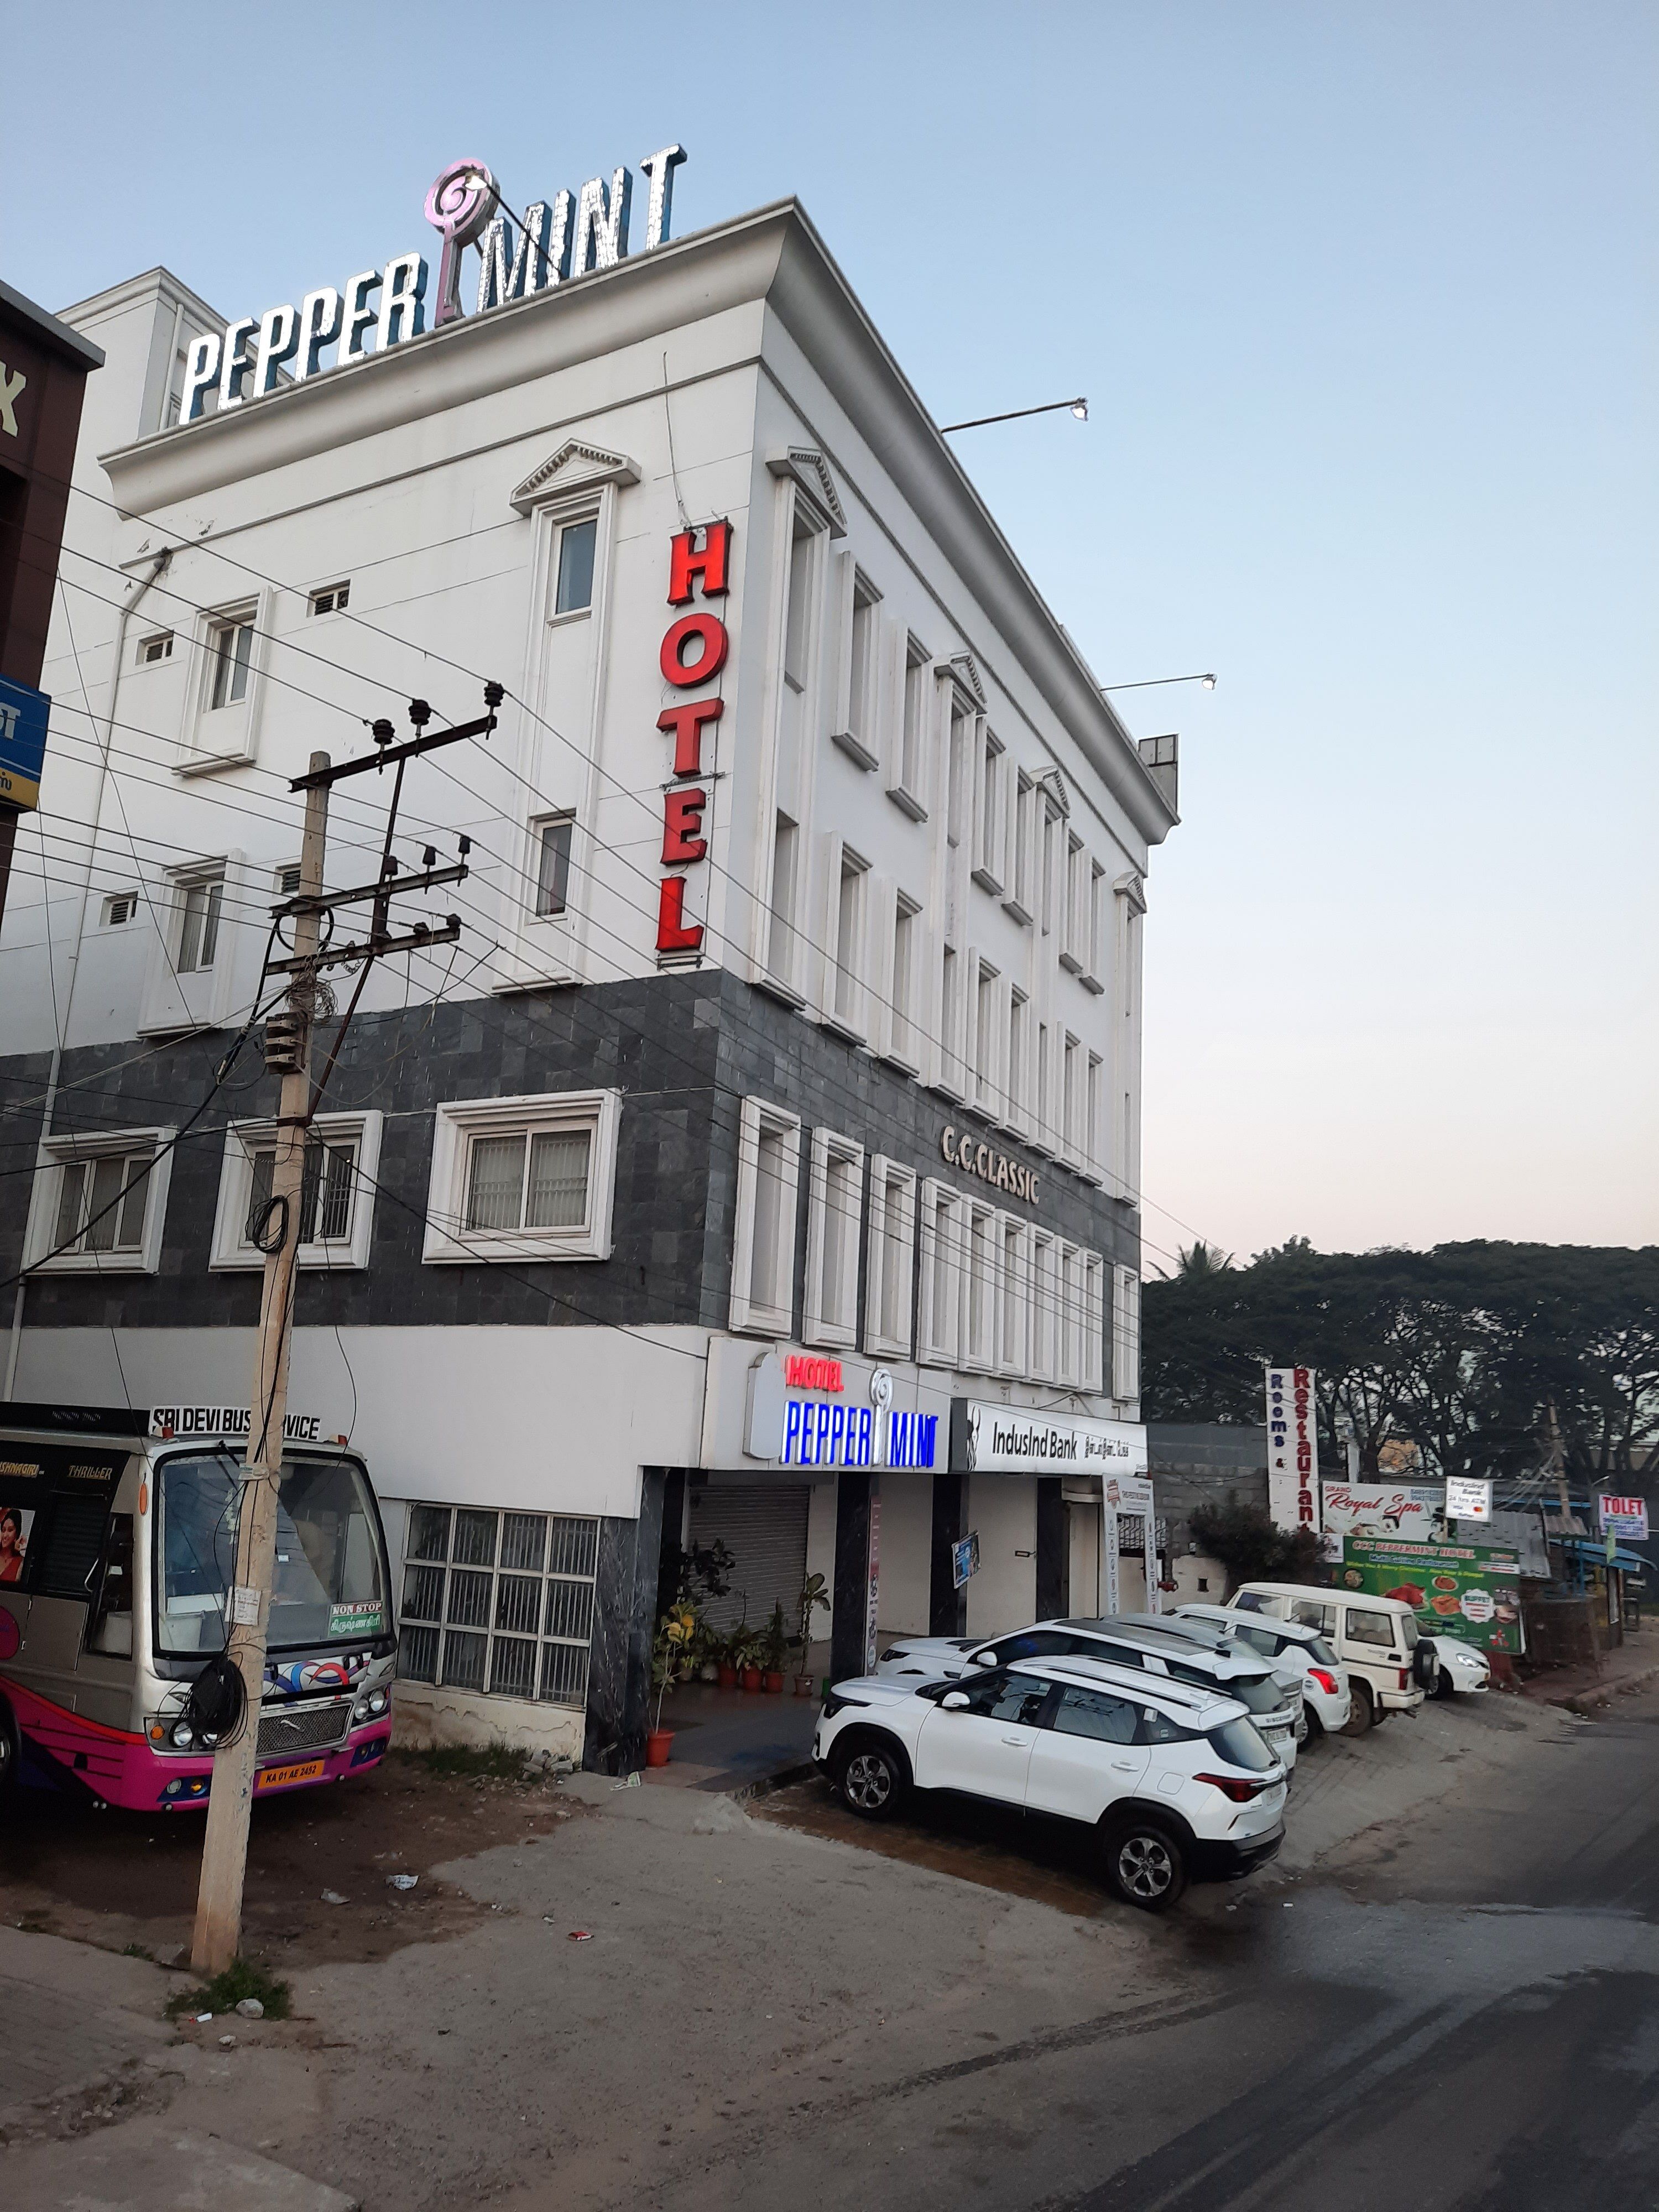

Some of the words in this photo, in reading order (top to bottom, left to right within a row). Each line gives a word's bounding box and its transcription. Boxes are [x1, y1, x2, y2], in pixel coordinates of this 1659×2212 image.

[179, 252, 429, 425] PEPPER
[477, 143, 687, 314] MINT
[656, 521, 734, 952] HOTEL
[785, 1354, 844, 1392] HOTEL
[182, 1408, 221, 1432] DEVI
[222, 1409, 251, 1432] BUS
[283, 1413, 320, 1439] VICE
[1270, 1374, 1287, 1447] Rooms
[779, 1400, 872, 1466] PEPPER
[886, 1411, 939, 1468] MINT
[992, 1421, 1049, 1458] IndusInd
[1050, 1430, 1078, 1460] Bank
[1293, 1368, 1314, 1530] Restauran
[68, 1465, 113, 1480] THRILLER
[1324, 1493, 1384, 1517] Royal
[1384, 1494, 1425, 1521] Spa
[332, 1605, 354, 1615] NON
[356, 1602, 382, 1613] STOP
[265, 1773, 276, 1783] KA
[278, 1771, 288, 1781] 01
[288, 1769, 300, 1779] AE
